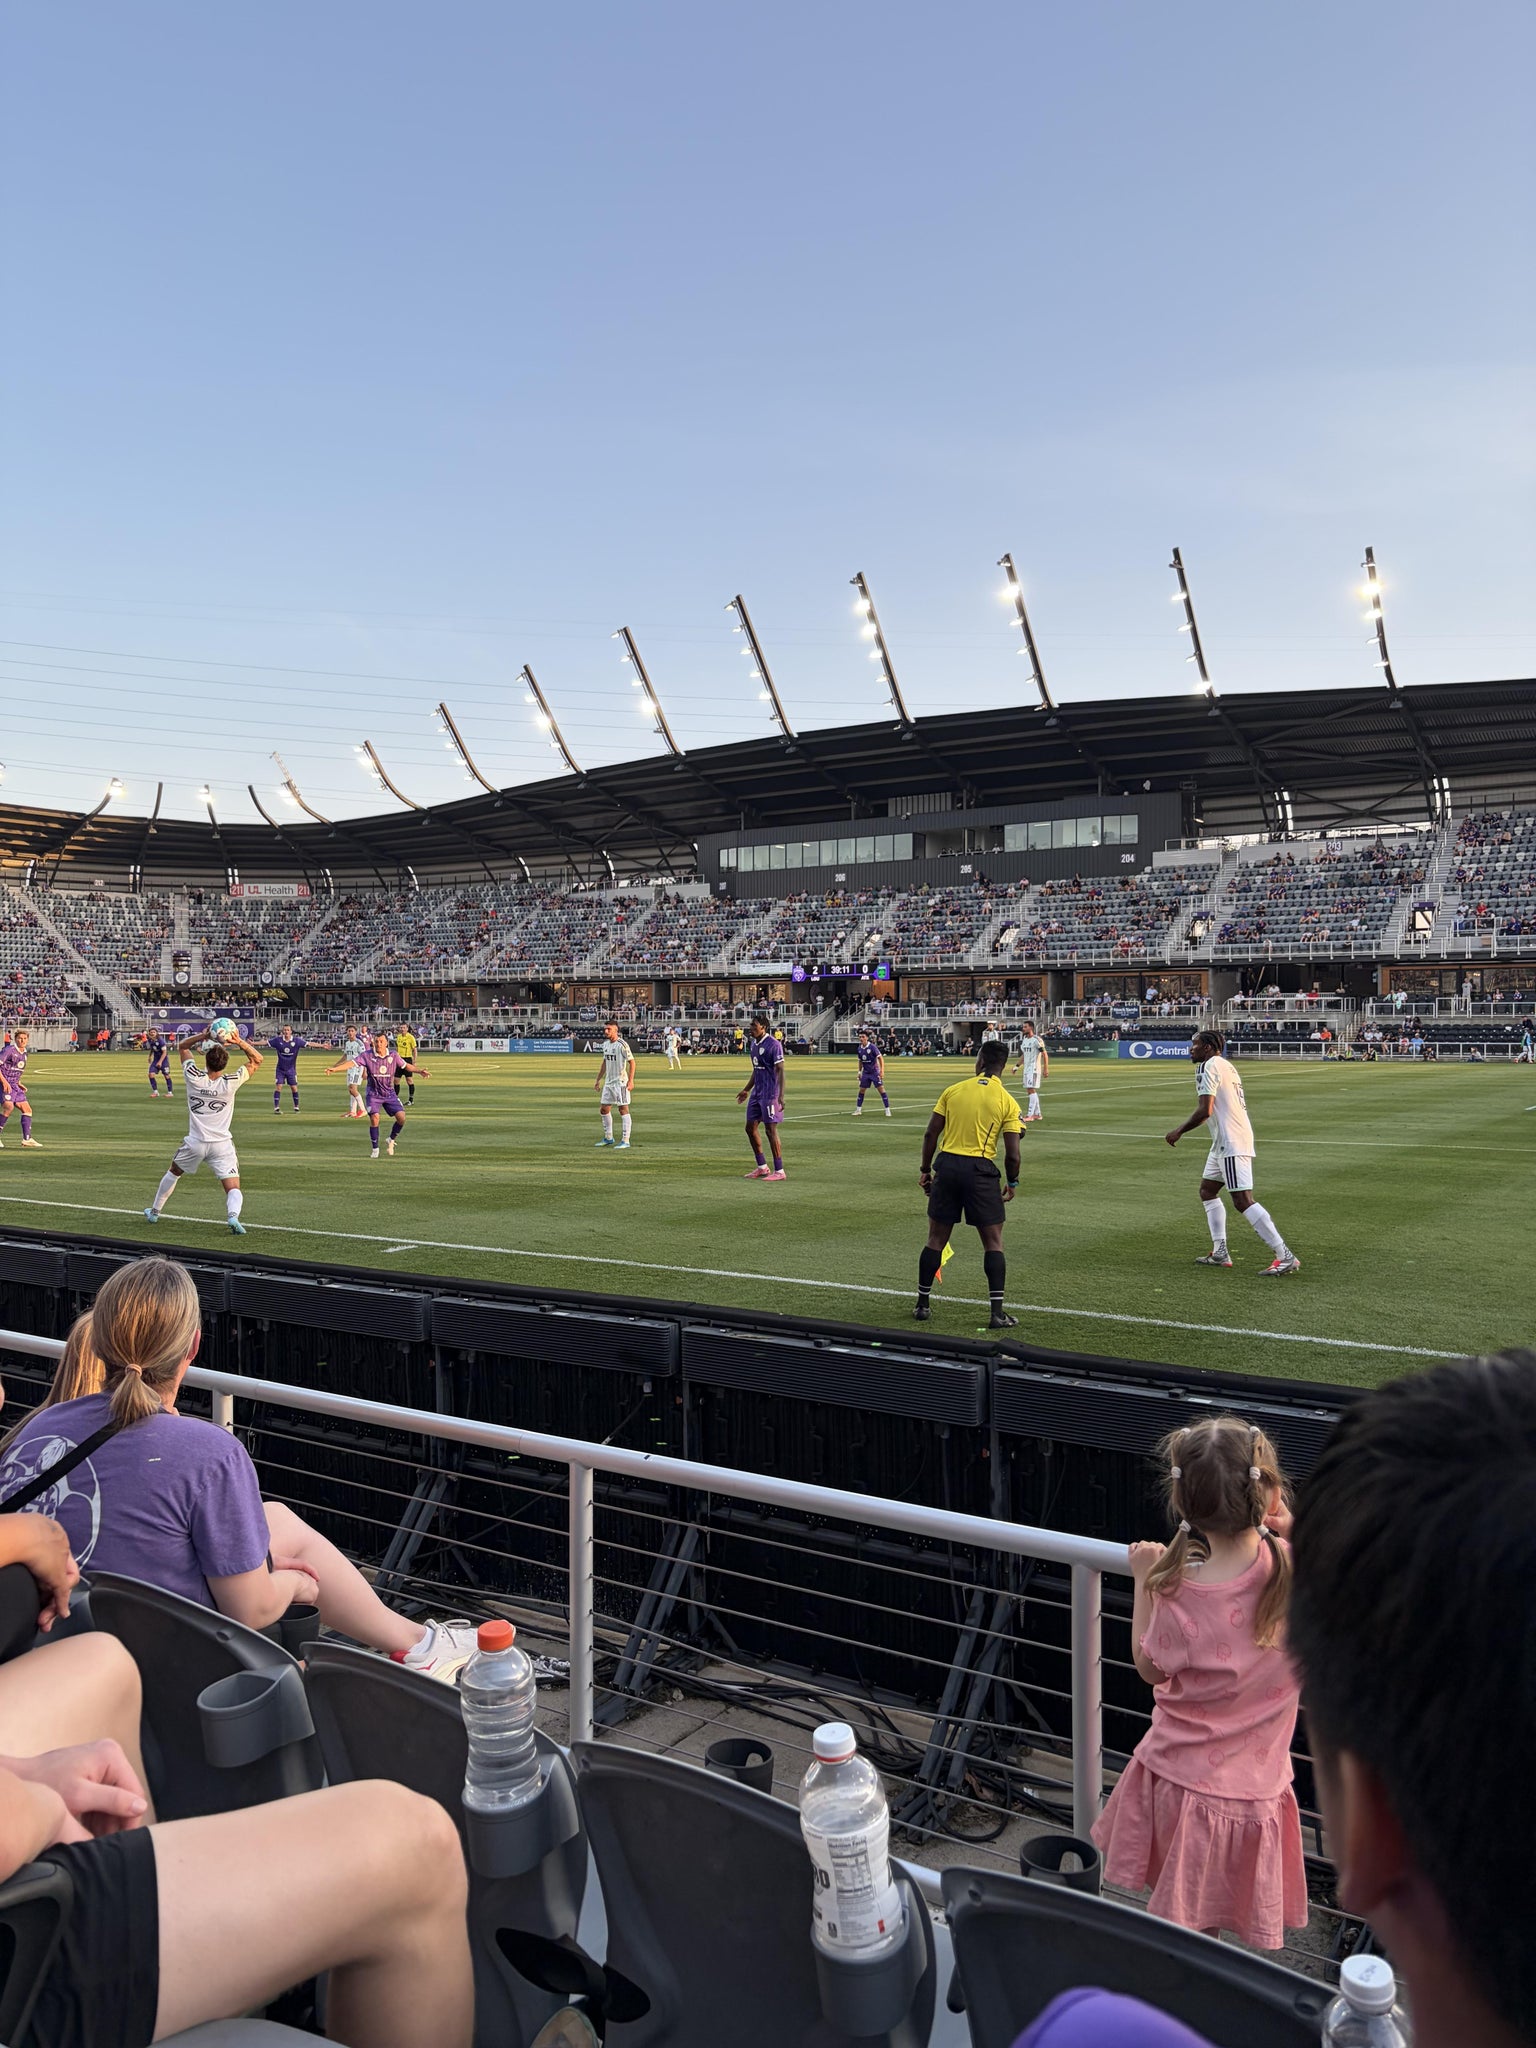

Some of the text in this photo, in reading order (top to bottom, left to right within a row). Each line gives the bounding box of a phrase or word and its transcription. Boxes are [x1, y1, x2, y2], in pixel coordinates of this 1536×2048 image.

[1121, 854, 1135, 864] 204
[231, 885, 244, 895] 211
[248, 885, 294, 895] UL Health
[298, 885, 310, 895] 211
[812, 966, 819, 975] 2
[830, 965, 850, 974] 39:11
[862, 965, 869, 974] 0
[1155, 1046, 1189, 1056] Central
[190, 1096, 227, 1115] 29
